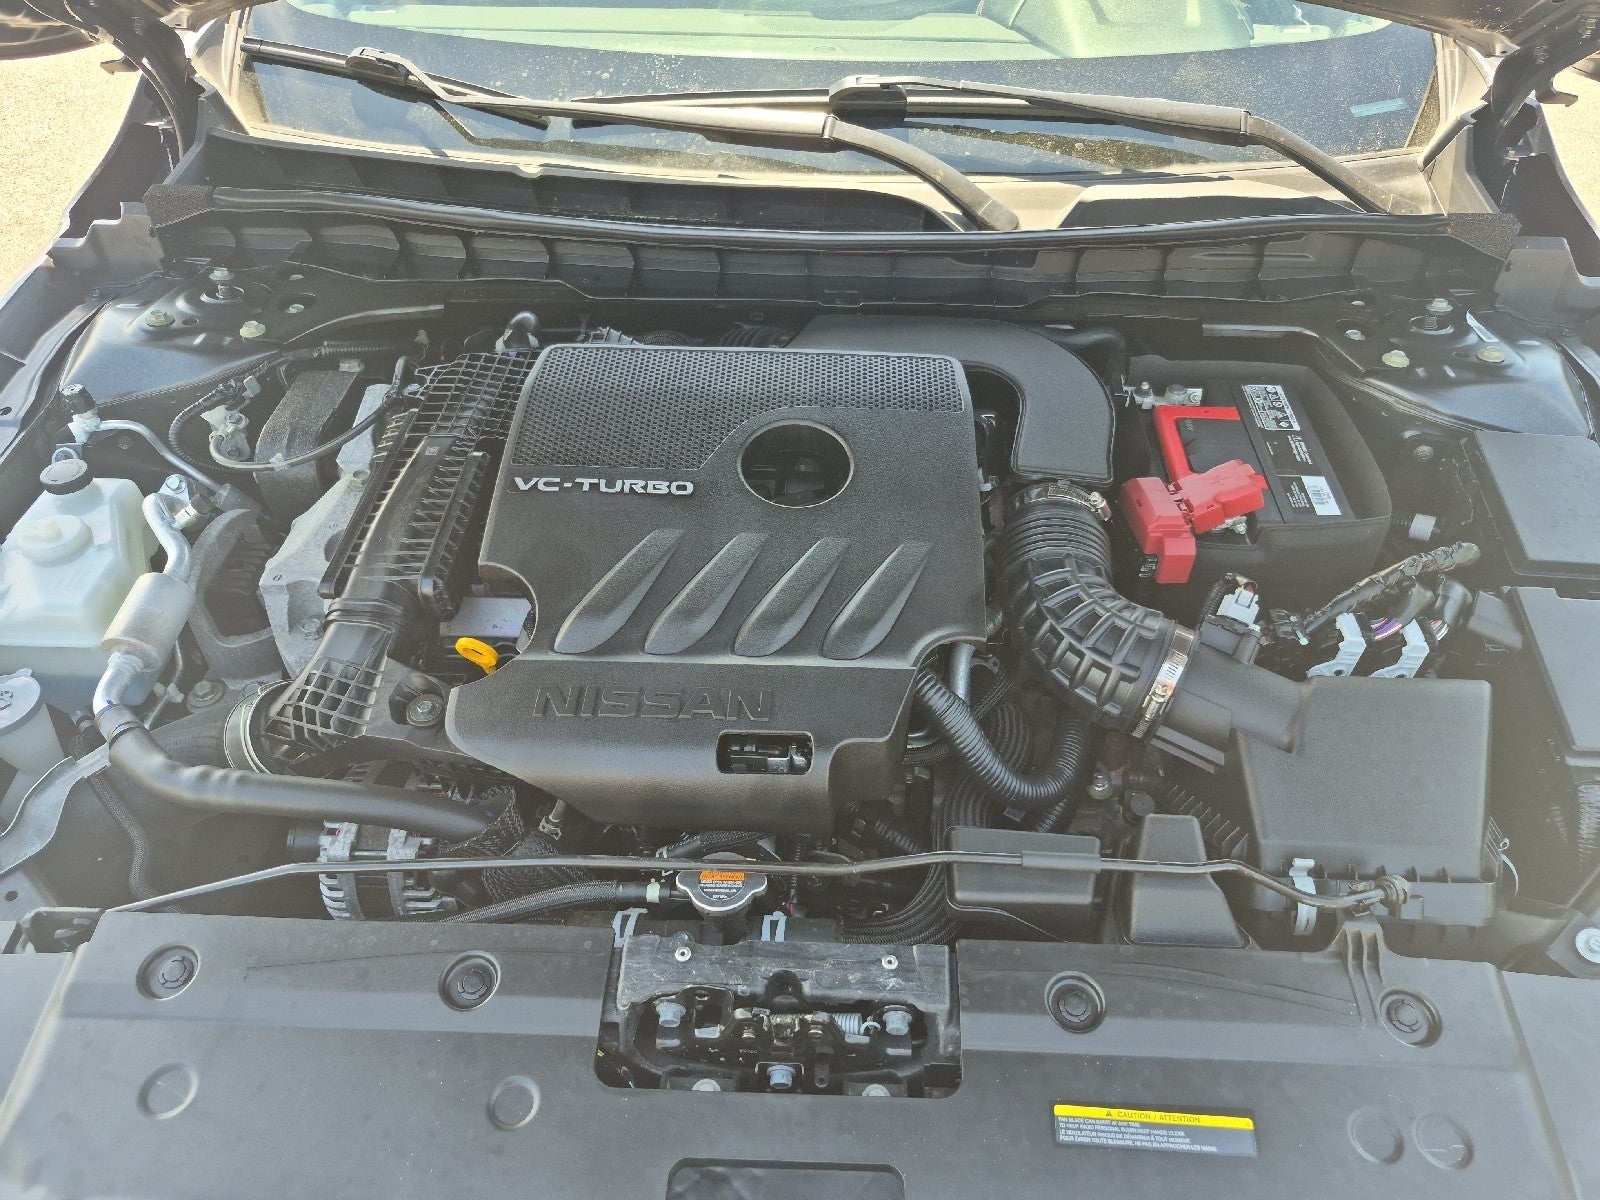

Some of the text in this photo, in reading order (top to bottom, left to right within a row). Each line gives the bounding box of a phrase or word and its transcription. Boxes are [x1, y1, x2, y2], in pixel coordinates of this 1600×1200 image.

[513, 476, 694, 496] VC-TURBO
[532, 684, 775, 721] NISSAN
[1118, 1111, 1151, 1120] CAUTION
